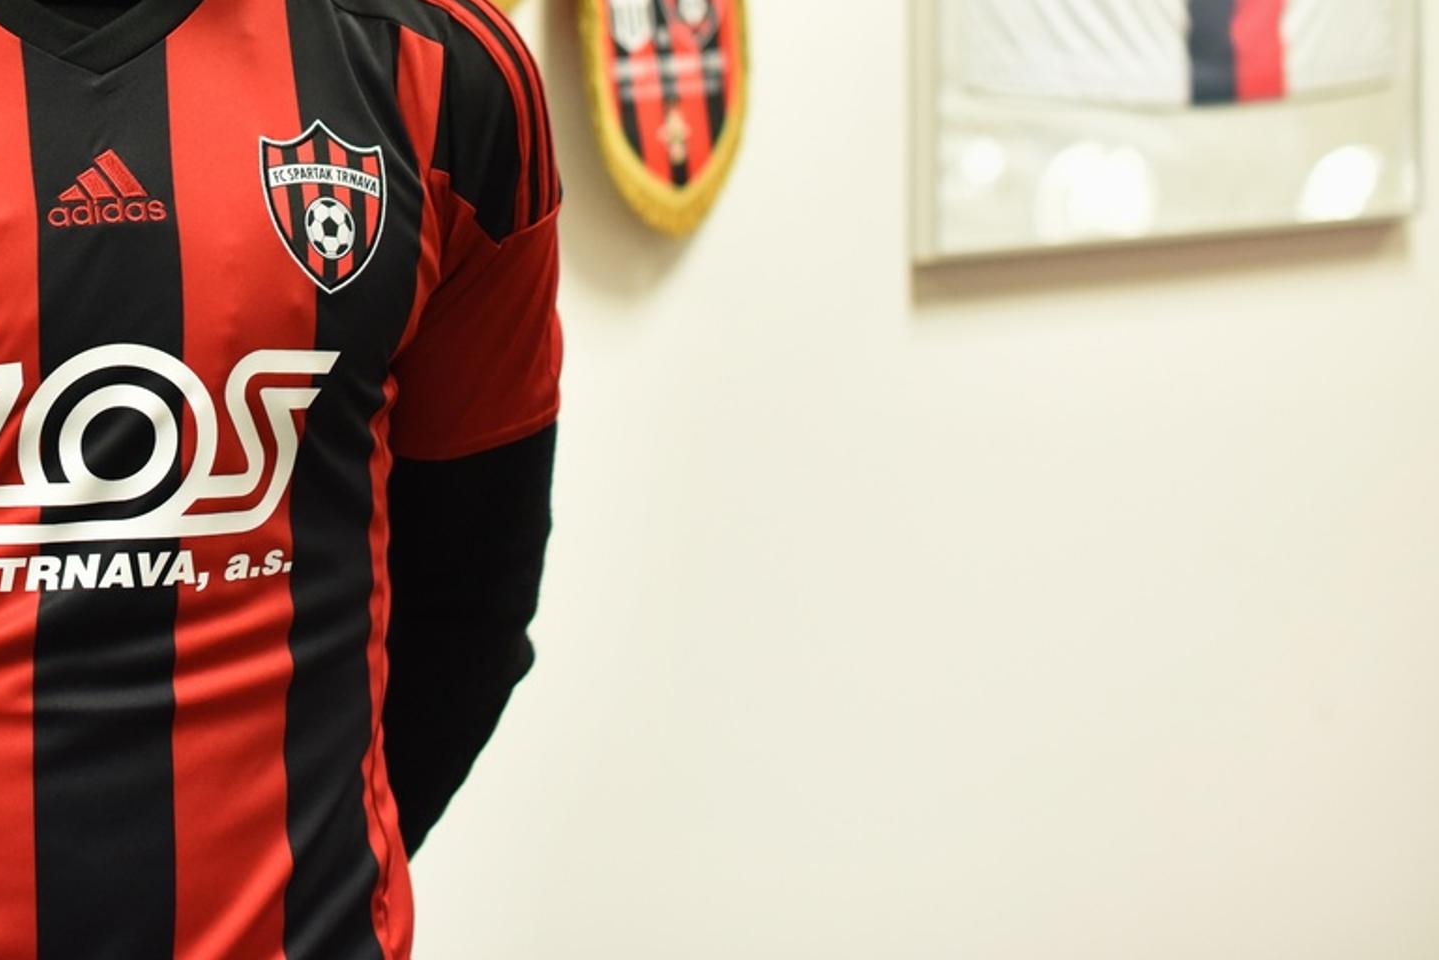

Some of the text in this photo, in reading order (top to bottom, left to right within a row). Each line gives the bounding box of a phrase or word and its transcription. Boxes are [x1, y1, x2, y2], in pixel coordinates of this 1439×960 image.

[273, 166, 377, 194] FC SPARTAK TRNAVA
[47, 197, 167, 227] adidas
[223, 549, 293, 581] a.s.
